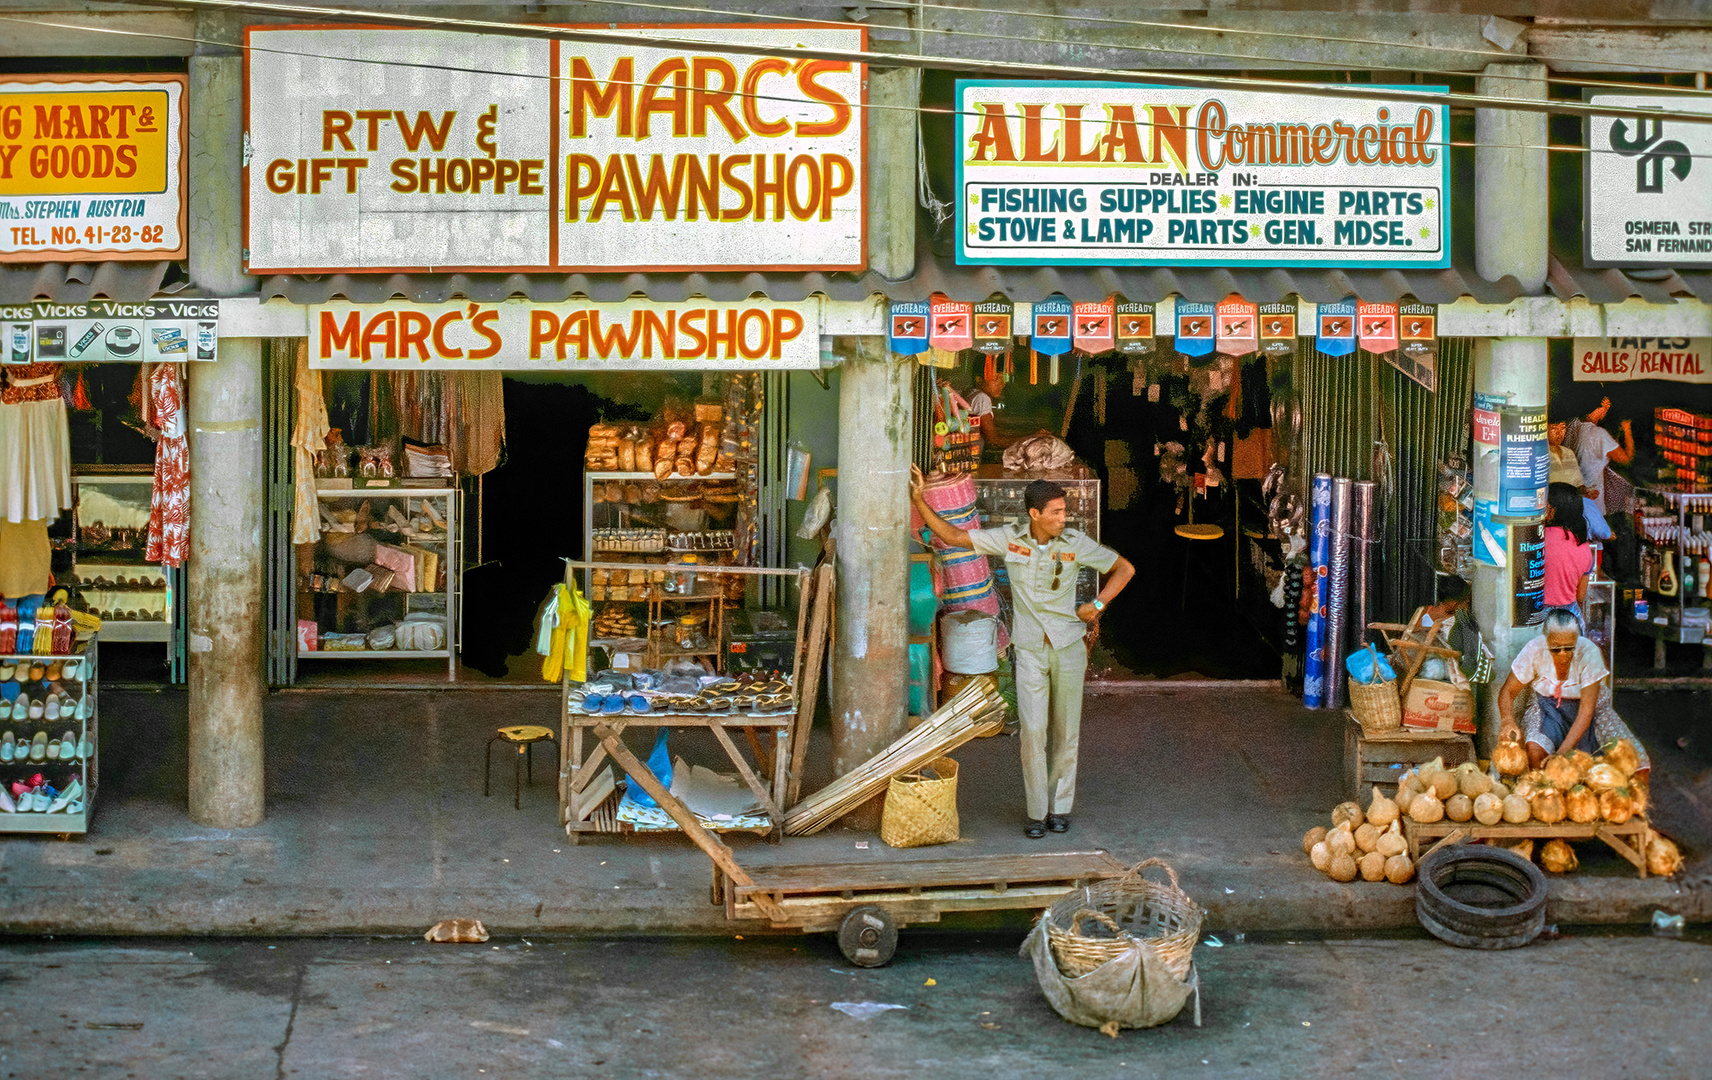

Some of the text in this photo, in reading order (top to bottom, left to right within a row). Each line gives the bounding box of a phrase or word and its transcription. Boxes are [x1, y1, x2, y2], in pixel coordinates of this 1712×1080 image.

[569, 44, 852, 143] MARC'S
[33, 105, 136, 139] MART
[137, 106, 157, 132] &
[322, 104, 498, 159] RTW &
[968, 98, 1438, 173] ALLAN Commercial
[30, 145, 138, 179] GOODS
[265, 158, 545, 195] GIFT SHOPPE
[1150, 173, 1258, 186] DEALER IN:
[565, 153, 854, 223] PAWNSHOP
[981, 188, 1423, 215] FISHING SUPPLIES ENGINE PARTS
[25, 200, 81, 219] STEPHEN
[86, 199, 146, 218] AUSTRIA
[10, 225, 164, 245] TEL. NO. 41-23-82
[978, 217, 1413, 246] STOVE & LAMP PARTS GEN. MDSE.
[1688, 221, 1712, 235] STR
[1626, 239, 1651, 252] SAN
[37, 304, 87, 317] VICKS
[103, 303, 155, 317] VICKS
[169, 303, 219, 317] VICKS
[933, 302, 970, 313] EVEREADY
[975, 303, 1012, 313] EVEREADY
[1035, 302, 1072, 313] EVEREADY
[1075, 303, 1113, 313] EVEREADY
[1117, 302, 1154, 313] EVEREADY
[1178, 303, 1215, 313] EVEREADY
[1219, 303, 1255, 313] EVEREADY
[1260, 303, 1296, 313] EVEREADY
[1320, 304, 1357, 314] EVEREADY
[1360, 304, 1396, 314] EVEREADY
[1400, 304, 1435, 314] EVEREADY
[320, 302, 804, 363] MARC'S PAWNSHOP
